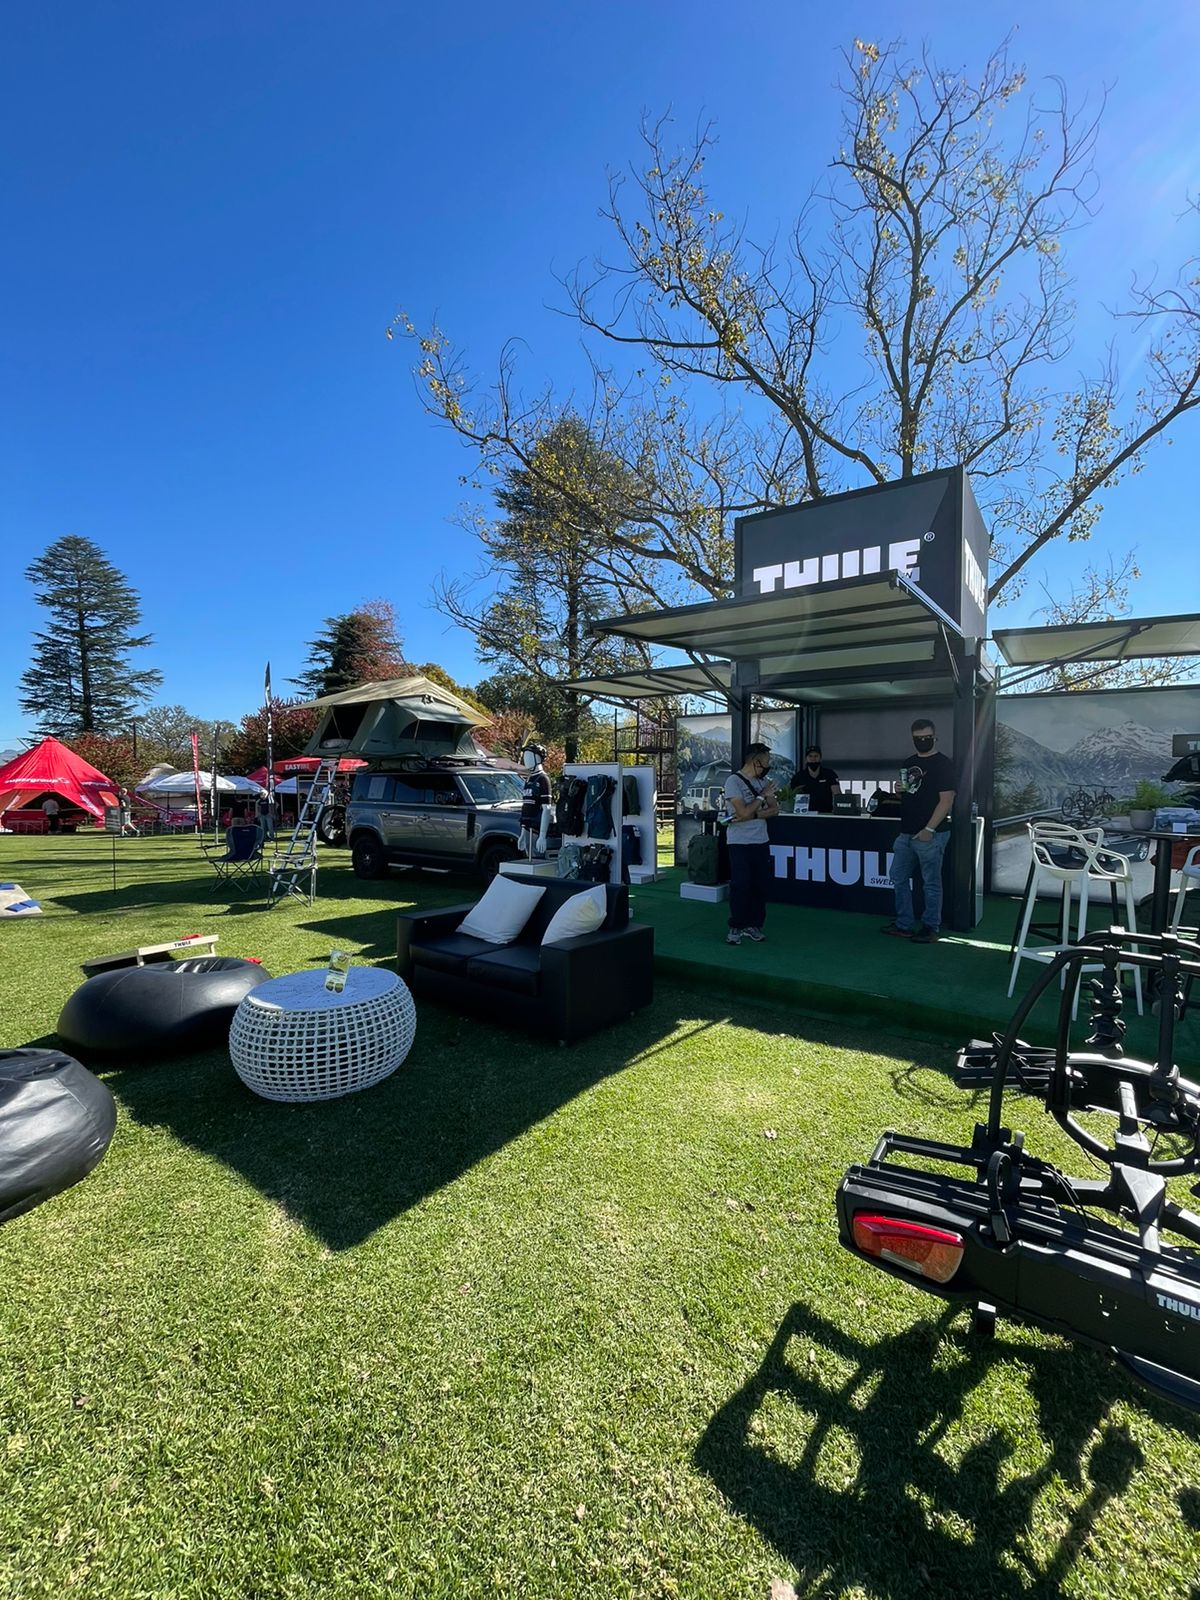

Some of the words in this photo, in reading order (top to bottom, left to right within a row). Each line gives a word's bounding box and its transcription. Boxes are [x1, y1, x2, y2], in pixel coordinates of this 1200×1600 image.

[769, 844, 913, 890] THUL
[870, 877, 896, 886] SWED
[1156, 1293, 1200, 1321] THUL
